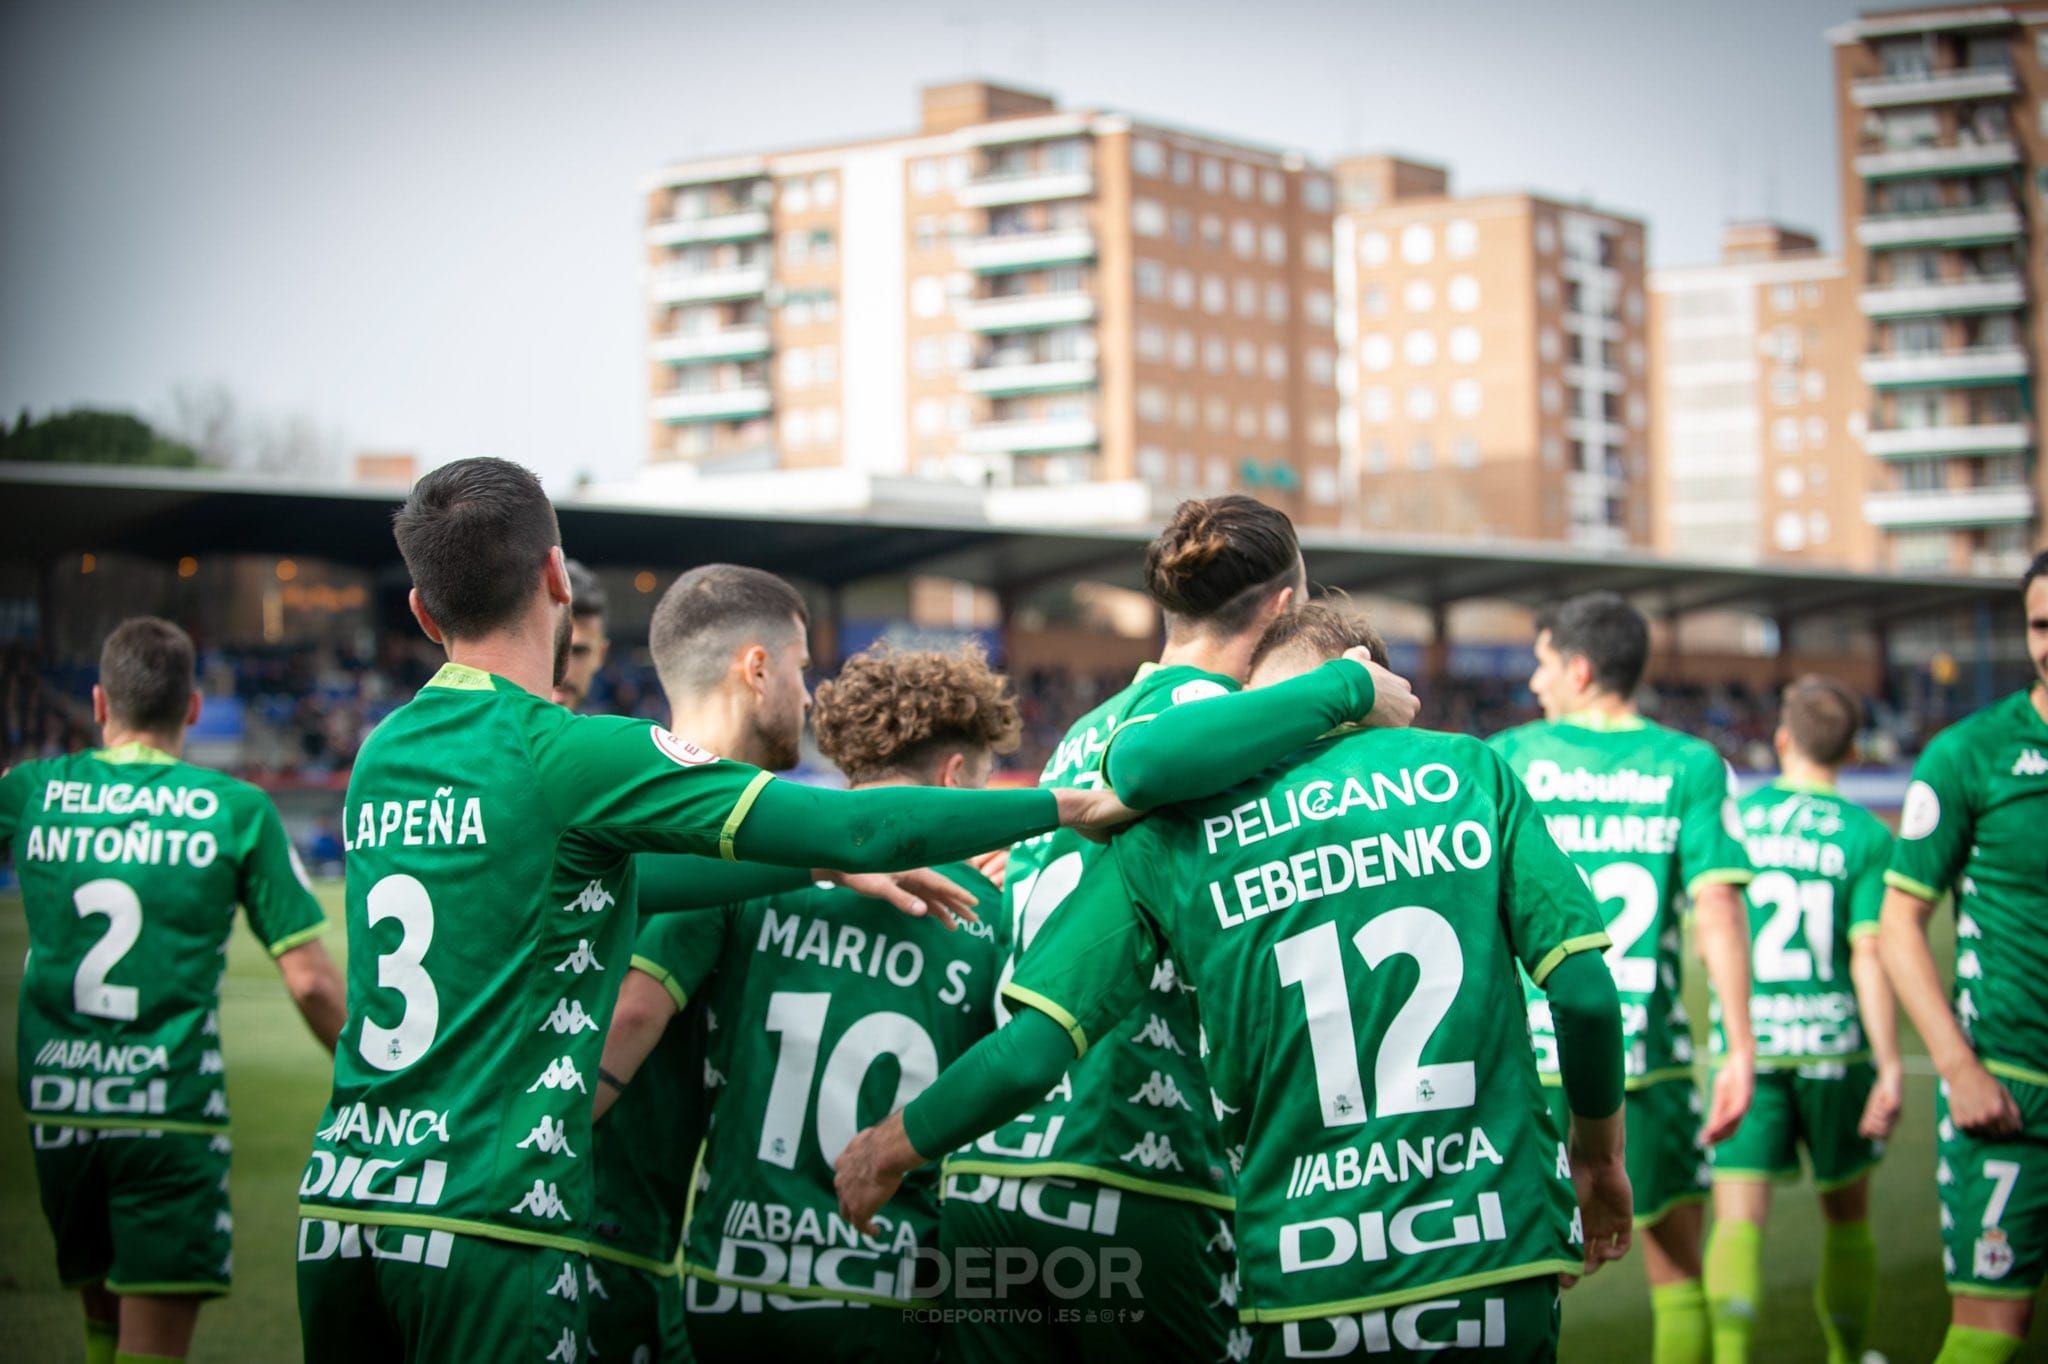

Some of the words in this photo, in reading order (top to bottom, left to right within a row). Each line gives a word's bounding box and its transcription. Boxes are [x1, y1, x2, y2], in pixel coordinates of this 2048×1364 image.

[43, 780, 219, 820] PELICANO
[342, 785, 487, 852] LAPEÑA
[1203, 763, 1459, 855] PELICANO
[27, 822, 218, 868] ANTOÑITO
[1209, 820, 1492, 930] LEBEDENKO
[73, 878, 142, 1022] 2
[756, 907, 925, 988] MARIO
[937, 959, 973, 1014] S.
[1748, 869, 1835, 983] 21
[358, 873, 439, 1072] 3
[1273, 905, 1477, 1128] 12
[30, 1074, 167, 1114] DIGI
[756, 991, 940, 1172] 10
[316, 1101, 450, 1148] ANCA
[298, 1149, 448, 1206] DIGI
[1980, 1159, 2021, 1229] 7
[297, 1217, 455, 1269] DIGI
[1278, 1191, 1507, 1274] DIGI
[715, 1236, 917, 1301] DIGI
[1283, 1298, 1506, 1359] DIGI
